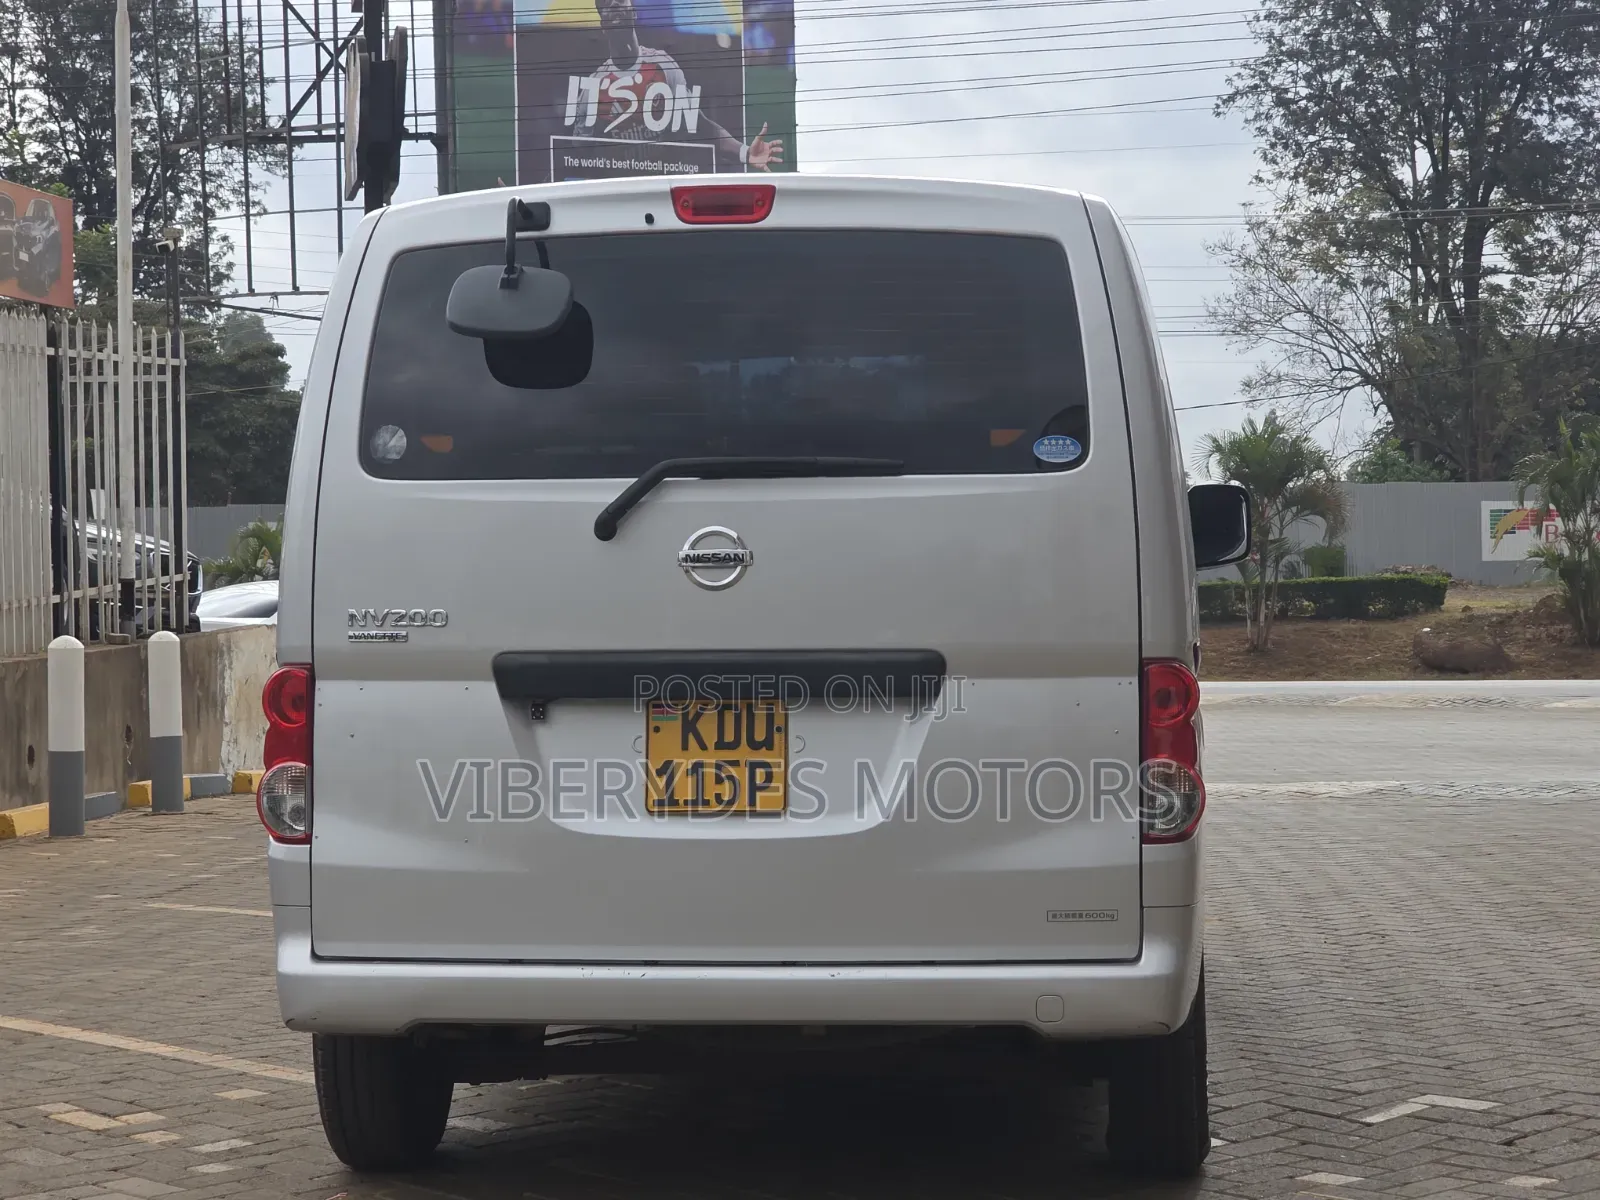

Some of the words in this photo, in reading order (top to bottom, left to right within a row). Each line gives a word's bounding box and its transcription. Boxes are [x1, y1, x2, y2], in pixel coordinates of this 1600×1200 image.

[564, 73, 643, 134] IT'S
[643, 82, 702, 134] ON
[563, 156, 580, 168] The
[580, 157, 611, 169] world's
[612, 159, 630, 170] best
[631, 158, 663, 172] football
[664, 161, 699, 175] package
[682, 552, 745, 565] NISSAN
[347, 608, 449, 628] NV200
[681, 702, 775, 751] KDU
[652, 759, 774, 806] 115P
